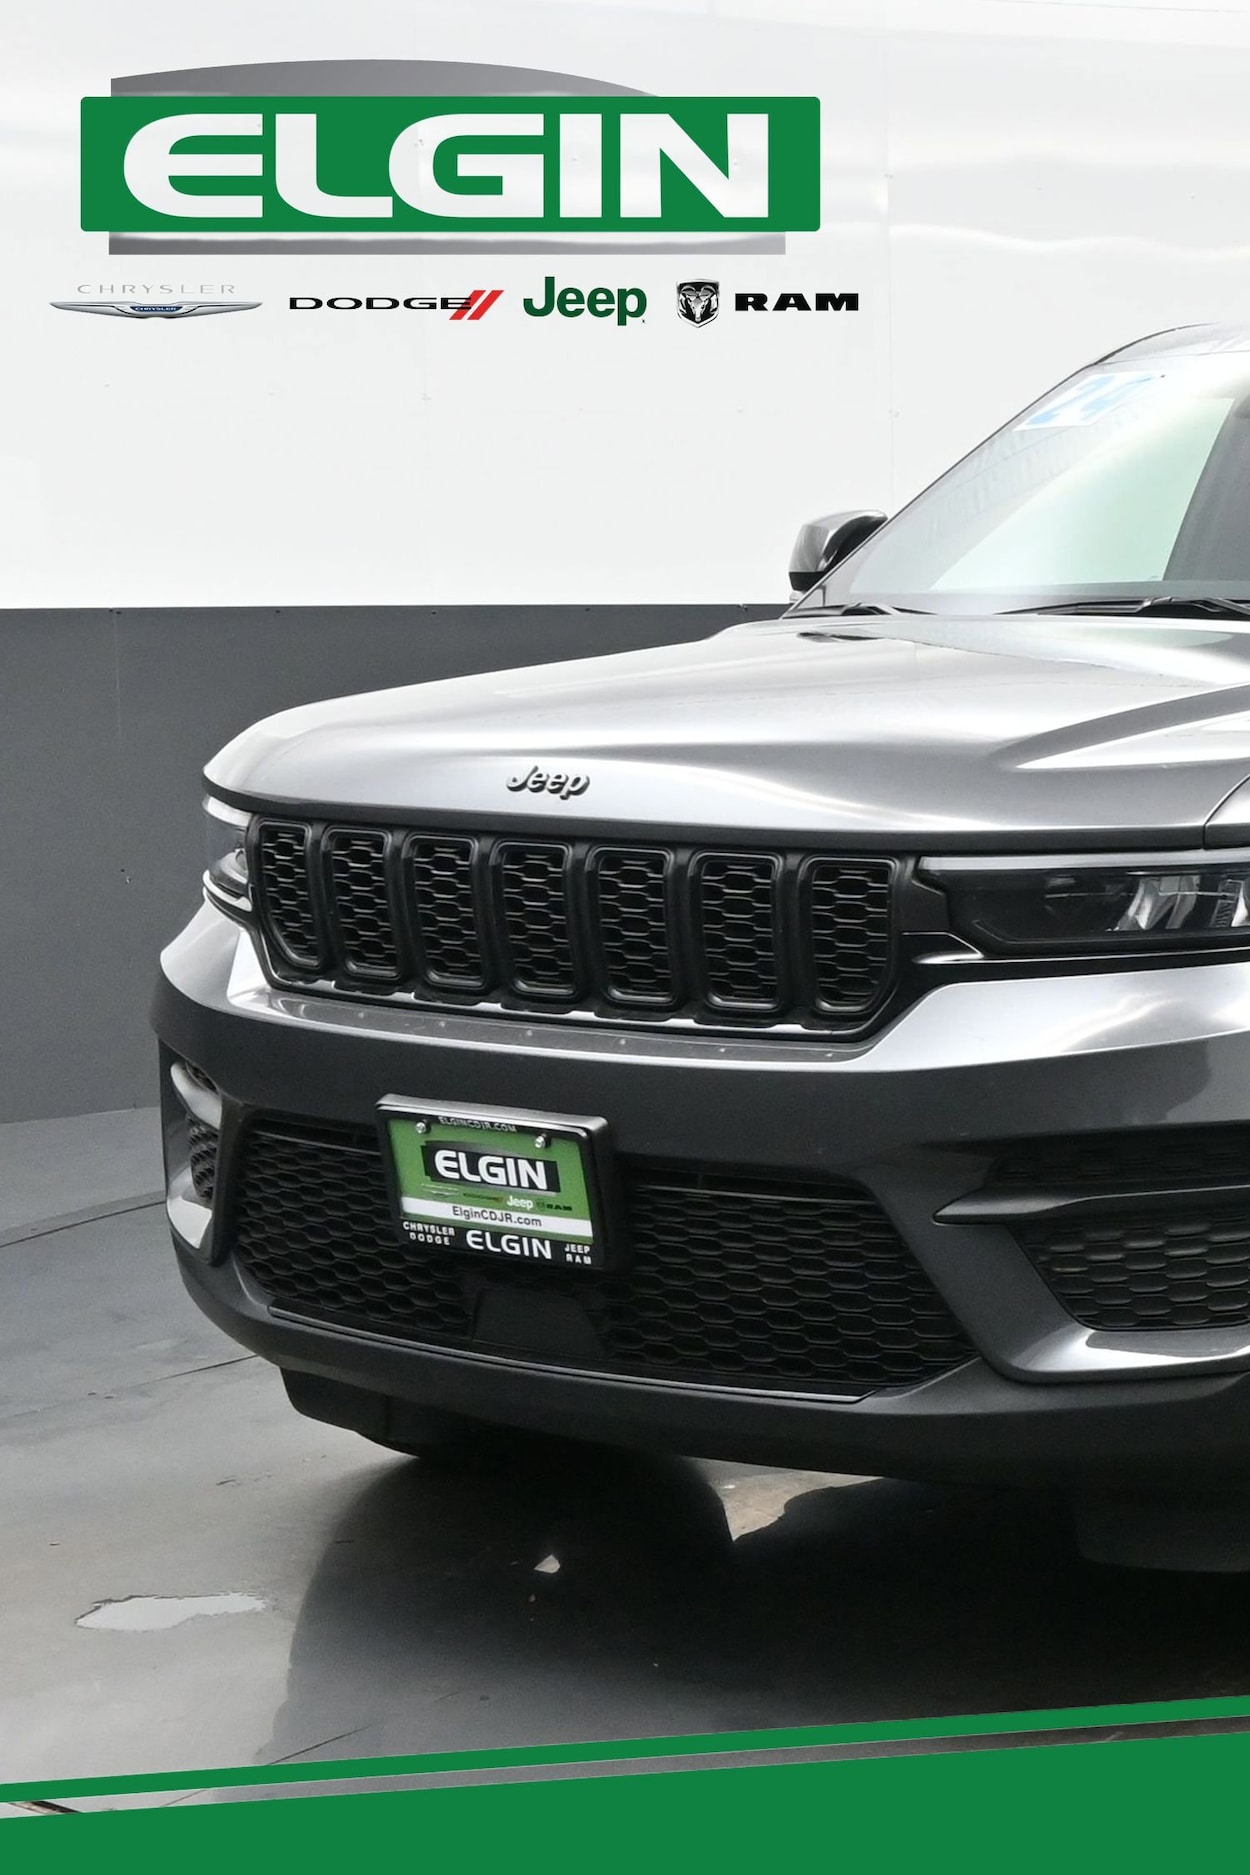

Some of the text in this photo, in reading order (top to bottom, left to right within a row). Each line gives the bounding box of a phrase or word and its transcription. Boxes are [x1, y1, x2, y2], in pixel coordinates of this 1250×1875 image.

[506, 765, 590, 801] Jeep
[434, 1149, 548, 1191] ELGIN
[506, 1195, 534, 1211] Jeep
[452, 1205, 542, 1228] ElginCDJR.com
[402, 1221, 456, 1237] CHRYSLER
[409, 1232, 451, 1246] DODGE
[466, 1230, 552, 1259] ELGIN
[564, 1243, 591, 1254] JEEP
[566, 1254, 592, 1265] RAM
